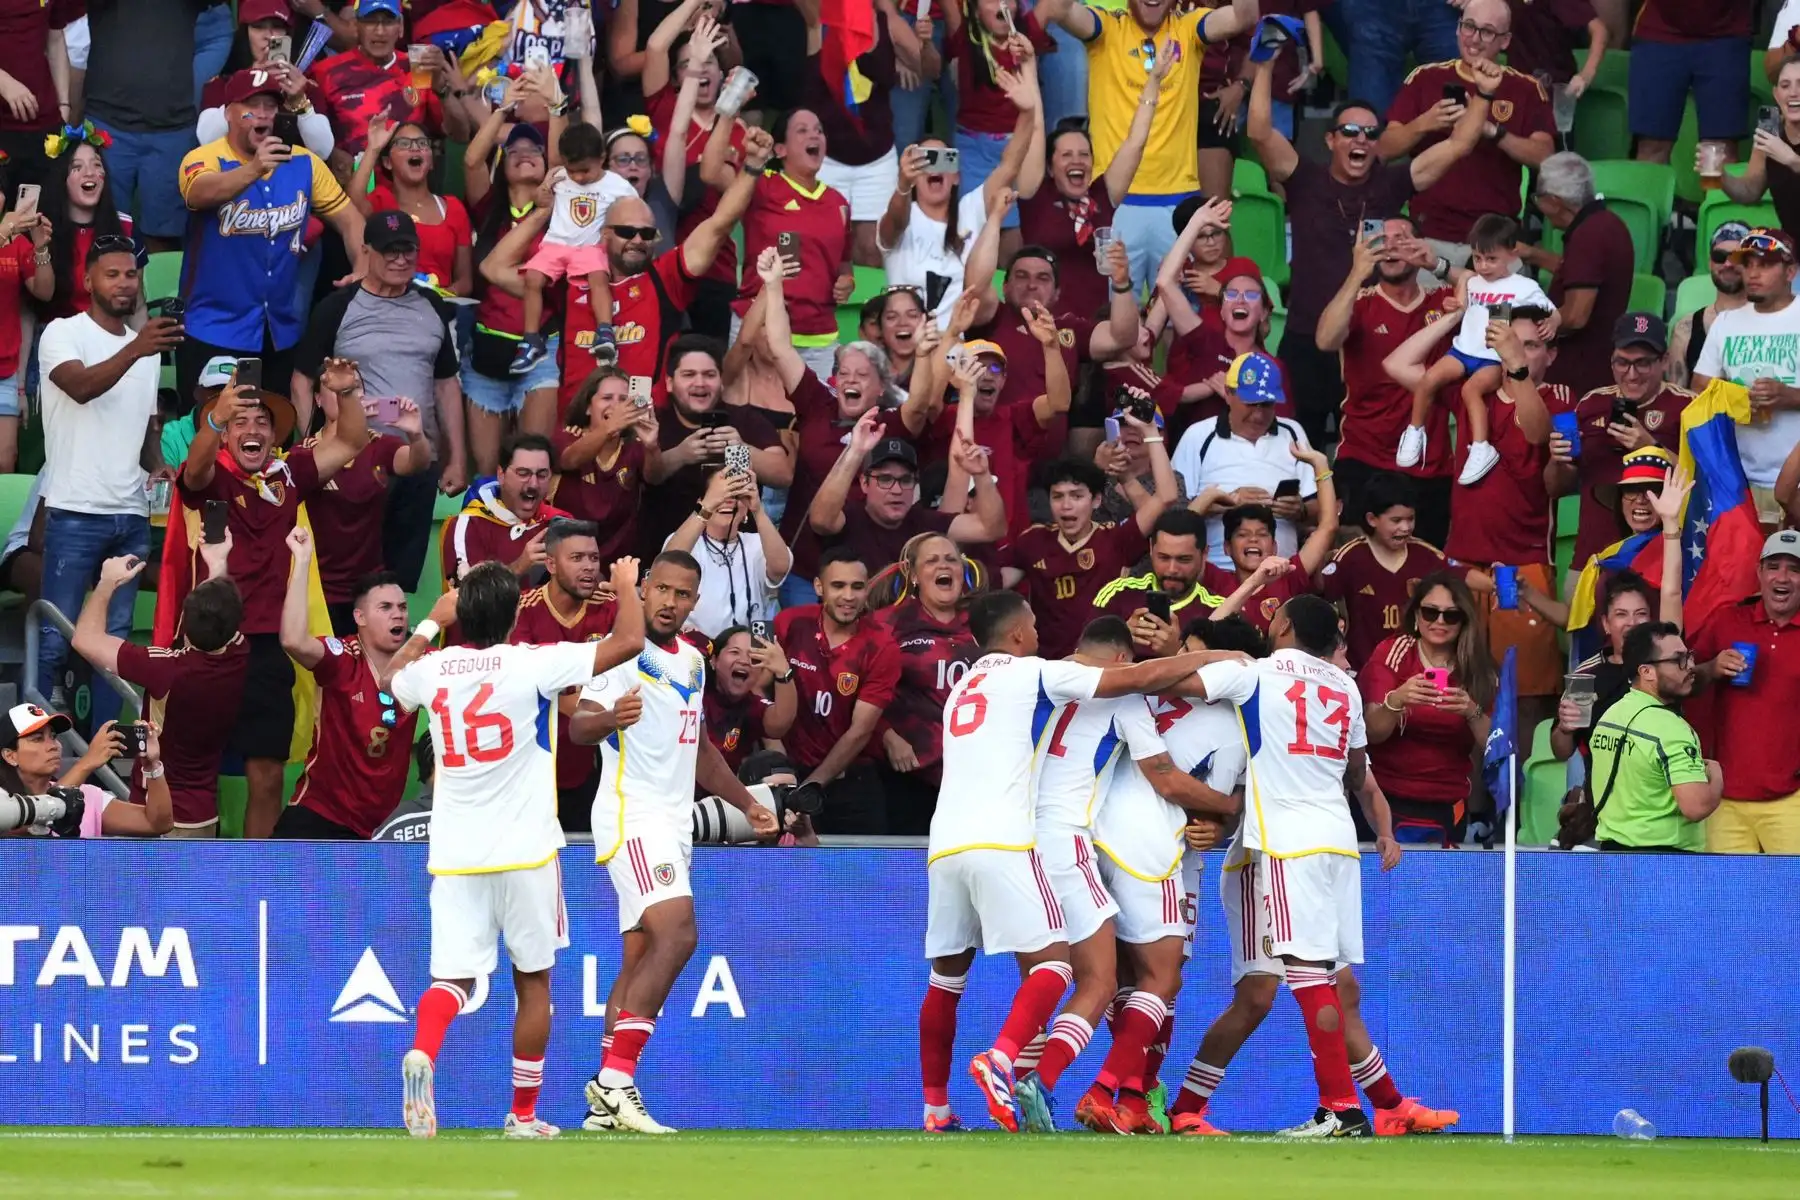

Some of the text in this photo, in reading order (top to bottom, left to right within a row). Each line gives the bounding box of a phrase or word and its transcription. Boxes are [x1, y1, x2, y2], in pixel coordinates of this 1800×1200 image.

[1722, 335, 1767, 367] NEW
[1054, 575, 1076, 600] 10
[1382, 604, 1401, 629] 10
[439, 656, 502, 676] SEGOVIA
[814, 690, 833, 717] 10
[949, 672, 988, 738] 6
[431, 682, 515, 768] 16
[678, 710, 698, 744] 23
[1283, 679, 1352, 761] 13
[367, 726, 390, 758] 8
